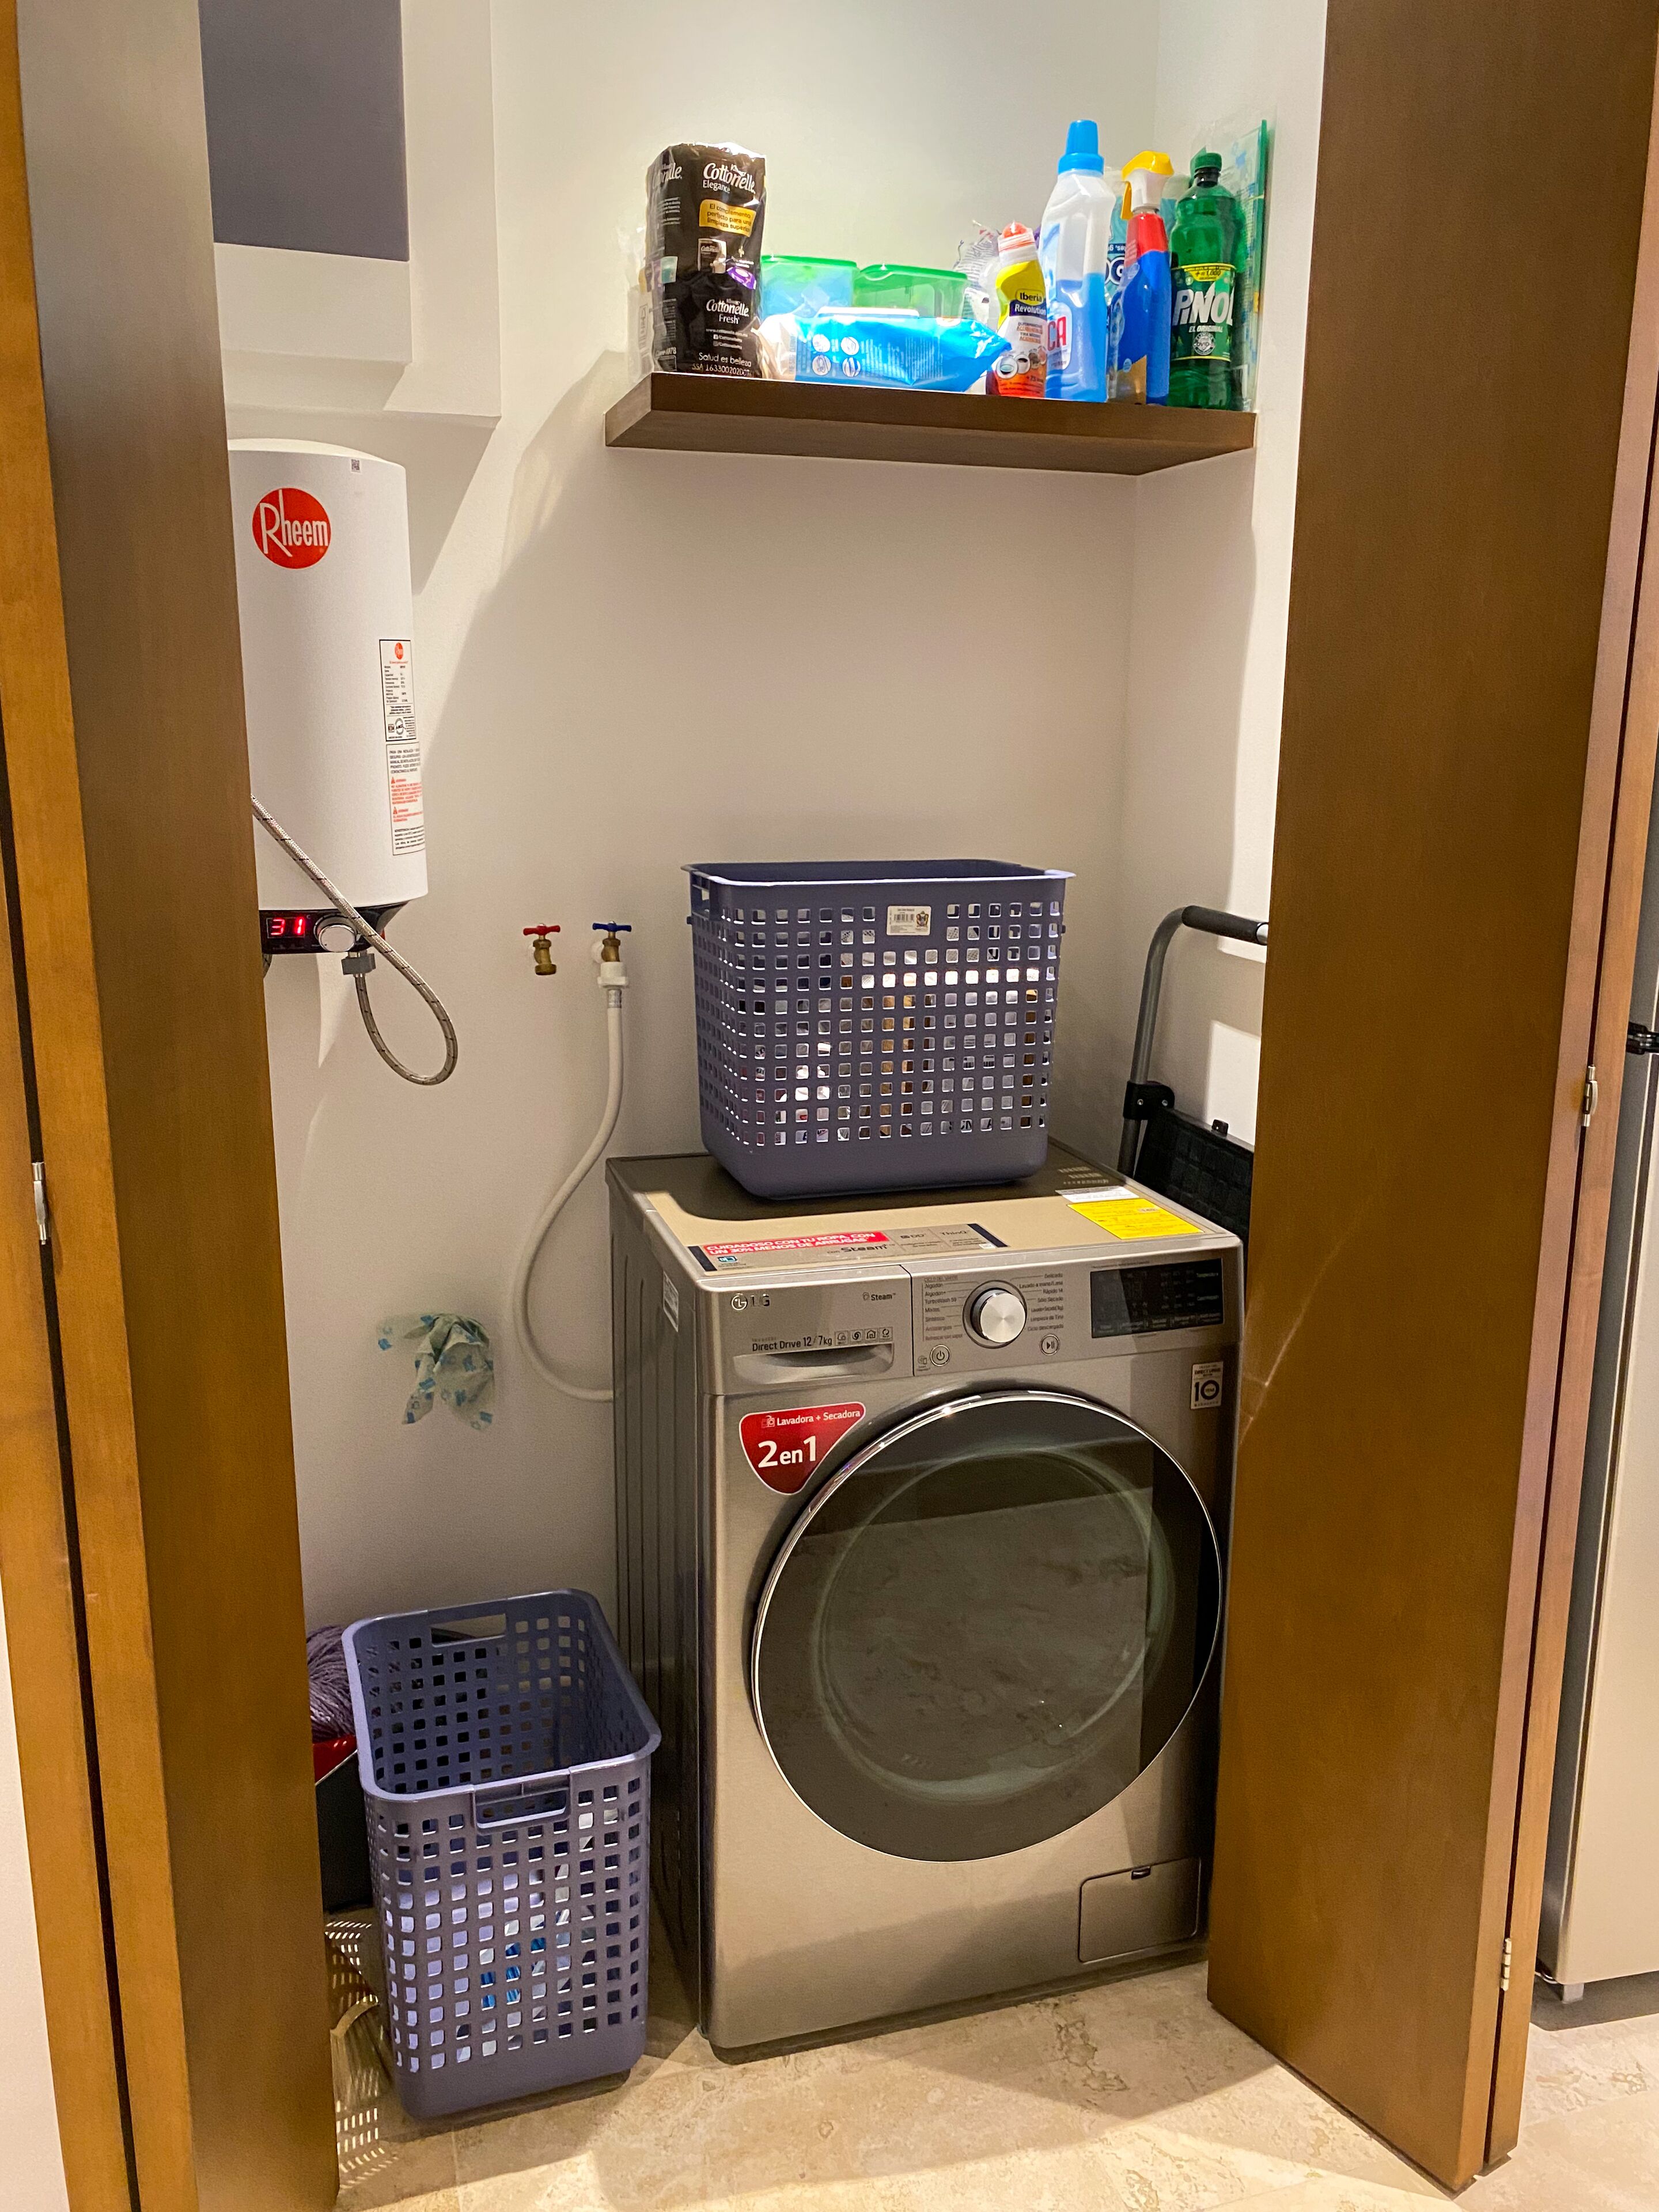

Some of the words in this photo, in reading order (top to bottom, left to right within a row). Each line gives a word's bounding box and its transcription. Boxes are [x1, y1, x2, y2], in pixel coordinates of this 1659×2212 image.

[703, 180, 730, 194] Elegance
[707, 217, 729, 228] limpieza
[1020, 291, 1042, 302] Iberia
[706, 299, 749, 317] Cottonelle
[1014, 304, 1046, 316] Revolution
[719, 314, 740, 324] Fresh
[699, 352, 719, 362] Salud
[729, 356, 752, 368] belleza
[260, 488, 328, 558] Rheem
[271, 917, 304, 936] 31
[707, 1241, 774, 1251] CUIDADOSO
[753, 1243, 796, 1251] MENOS
[750, 1293, 770, 1307] LG
[752, 1342, 778, 1352] Direct
[779, 1339, 801, 1350] Drive
[1194, 1379, 1220, 1402] 10
[777, 1415, 815, 1426] Lavadora
[823, 1410, 861, 1421] Secadora
